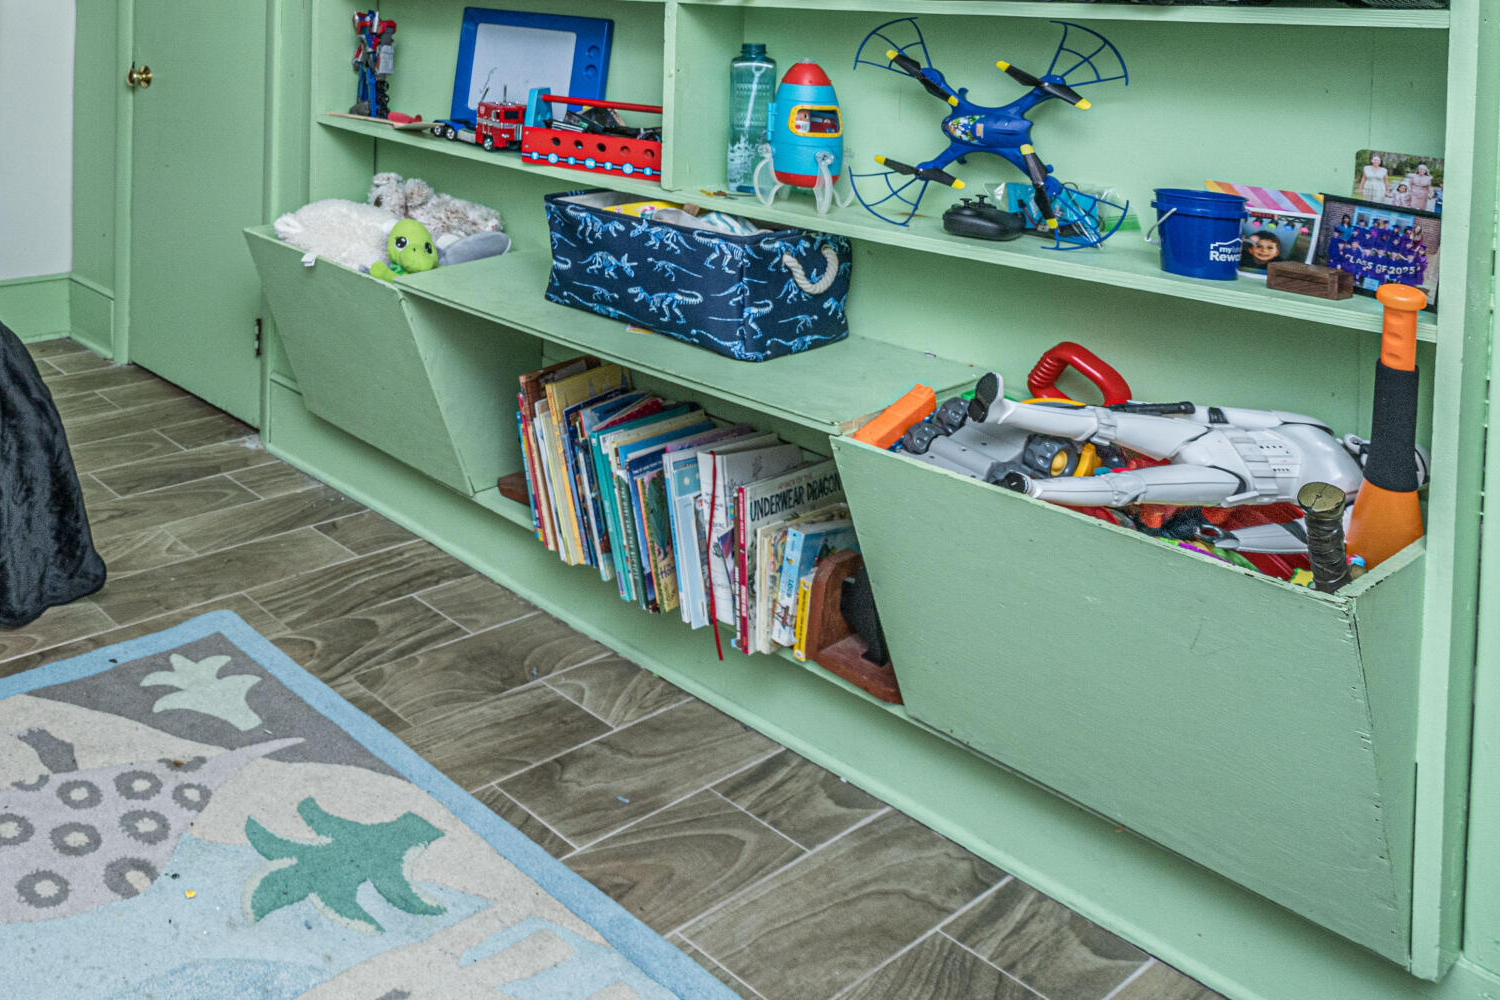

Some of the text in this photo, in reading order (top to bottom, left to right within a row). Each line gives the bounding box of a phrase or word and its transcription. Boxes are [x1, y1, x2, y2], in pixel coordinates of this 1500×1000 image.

[1344, 254, 1374, 271] CLASS
[1387, 266, 1416, 275] 2025
[749, 486, 805, 521] UNDERWEAR
[806, 473, 841, 501] DRAGON
